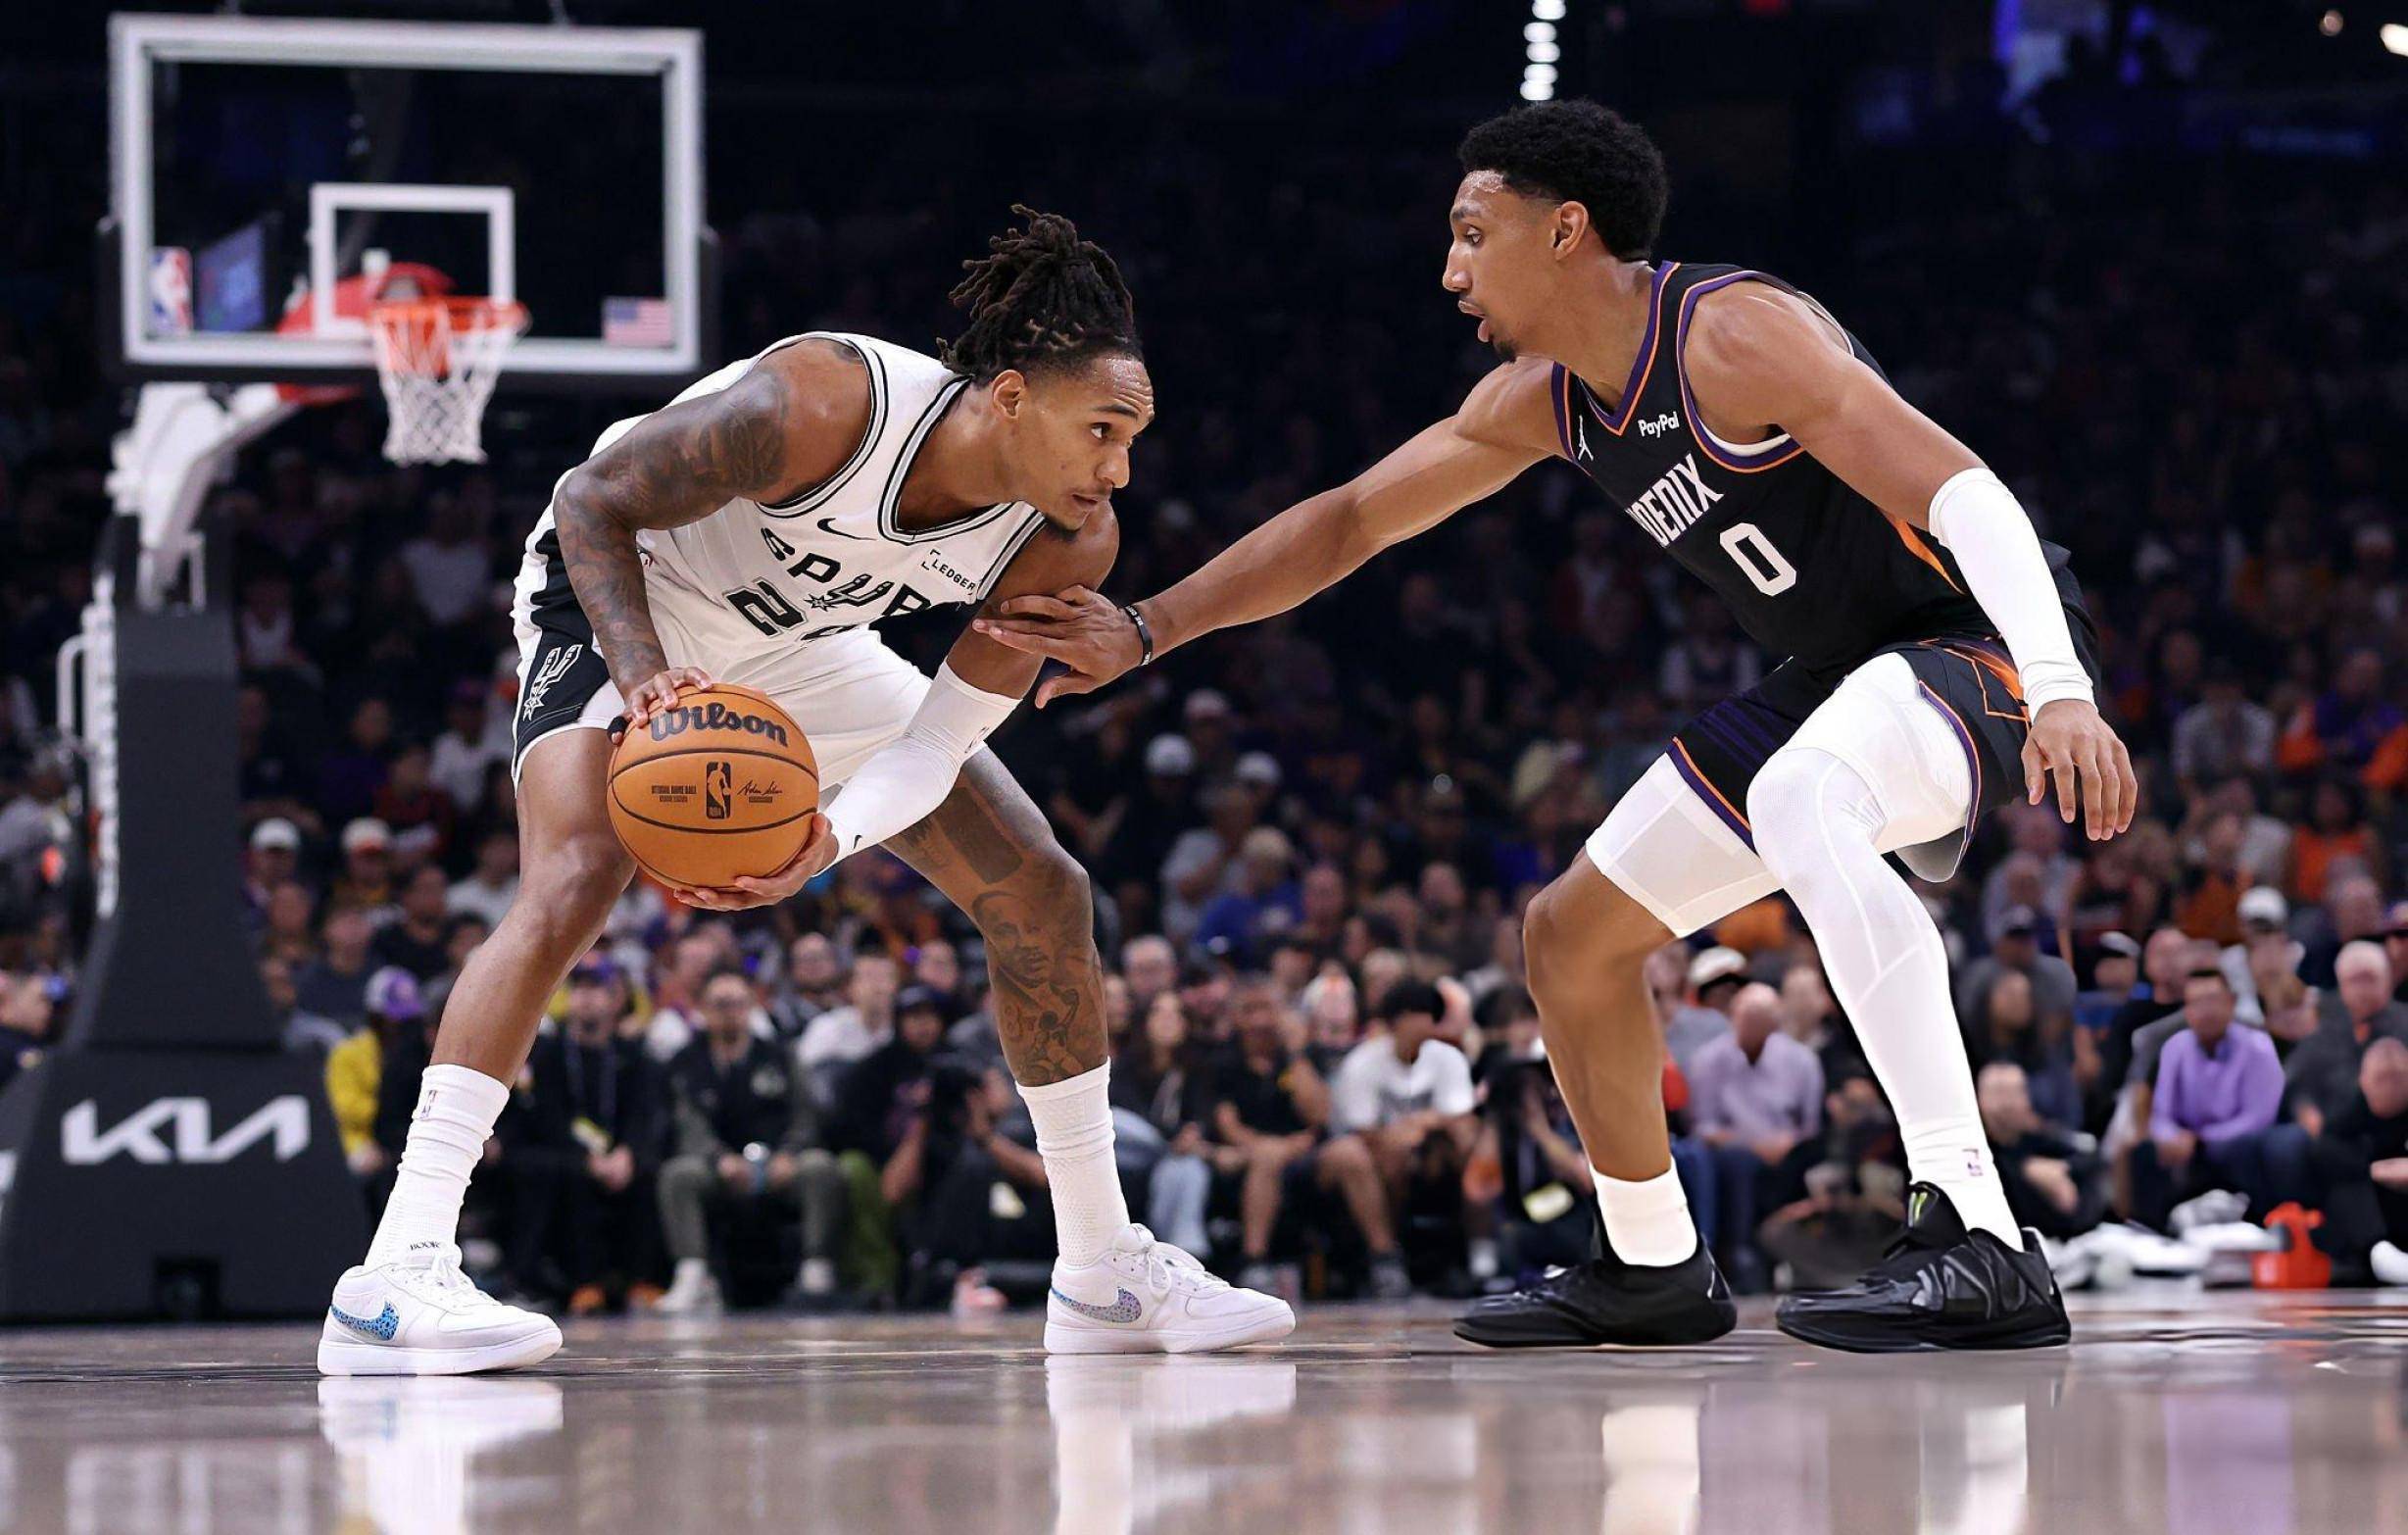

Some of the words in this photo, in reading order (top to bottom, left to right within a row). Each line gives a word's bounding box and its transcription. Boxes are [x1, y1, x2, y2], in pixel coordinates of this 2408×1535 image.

[1637, 411, 1680, 438] PayPal
[1625, 452, 1725, 549] OENIX
[931, 558, 976, 591] LEDGER
[1719, 522, 1797, 597] 0
[650, 702, 789, 747] Wilson
[61, 1095, 312, 1164] KIA
